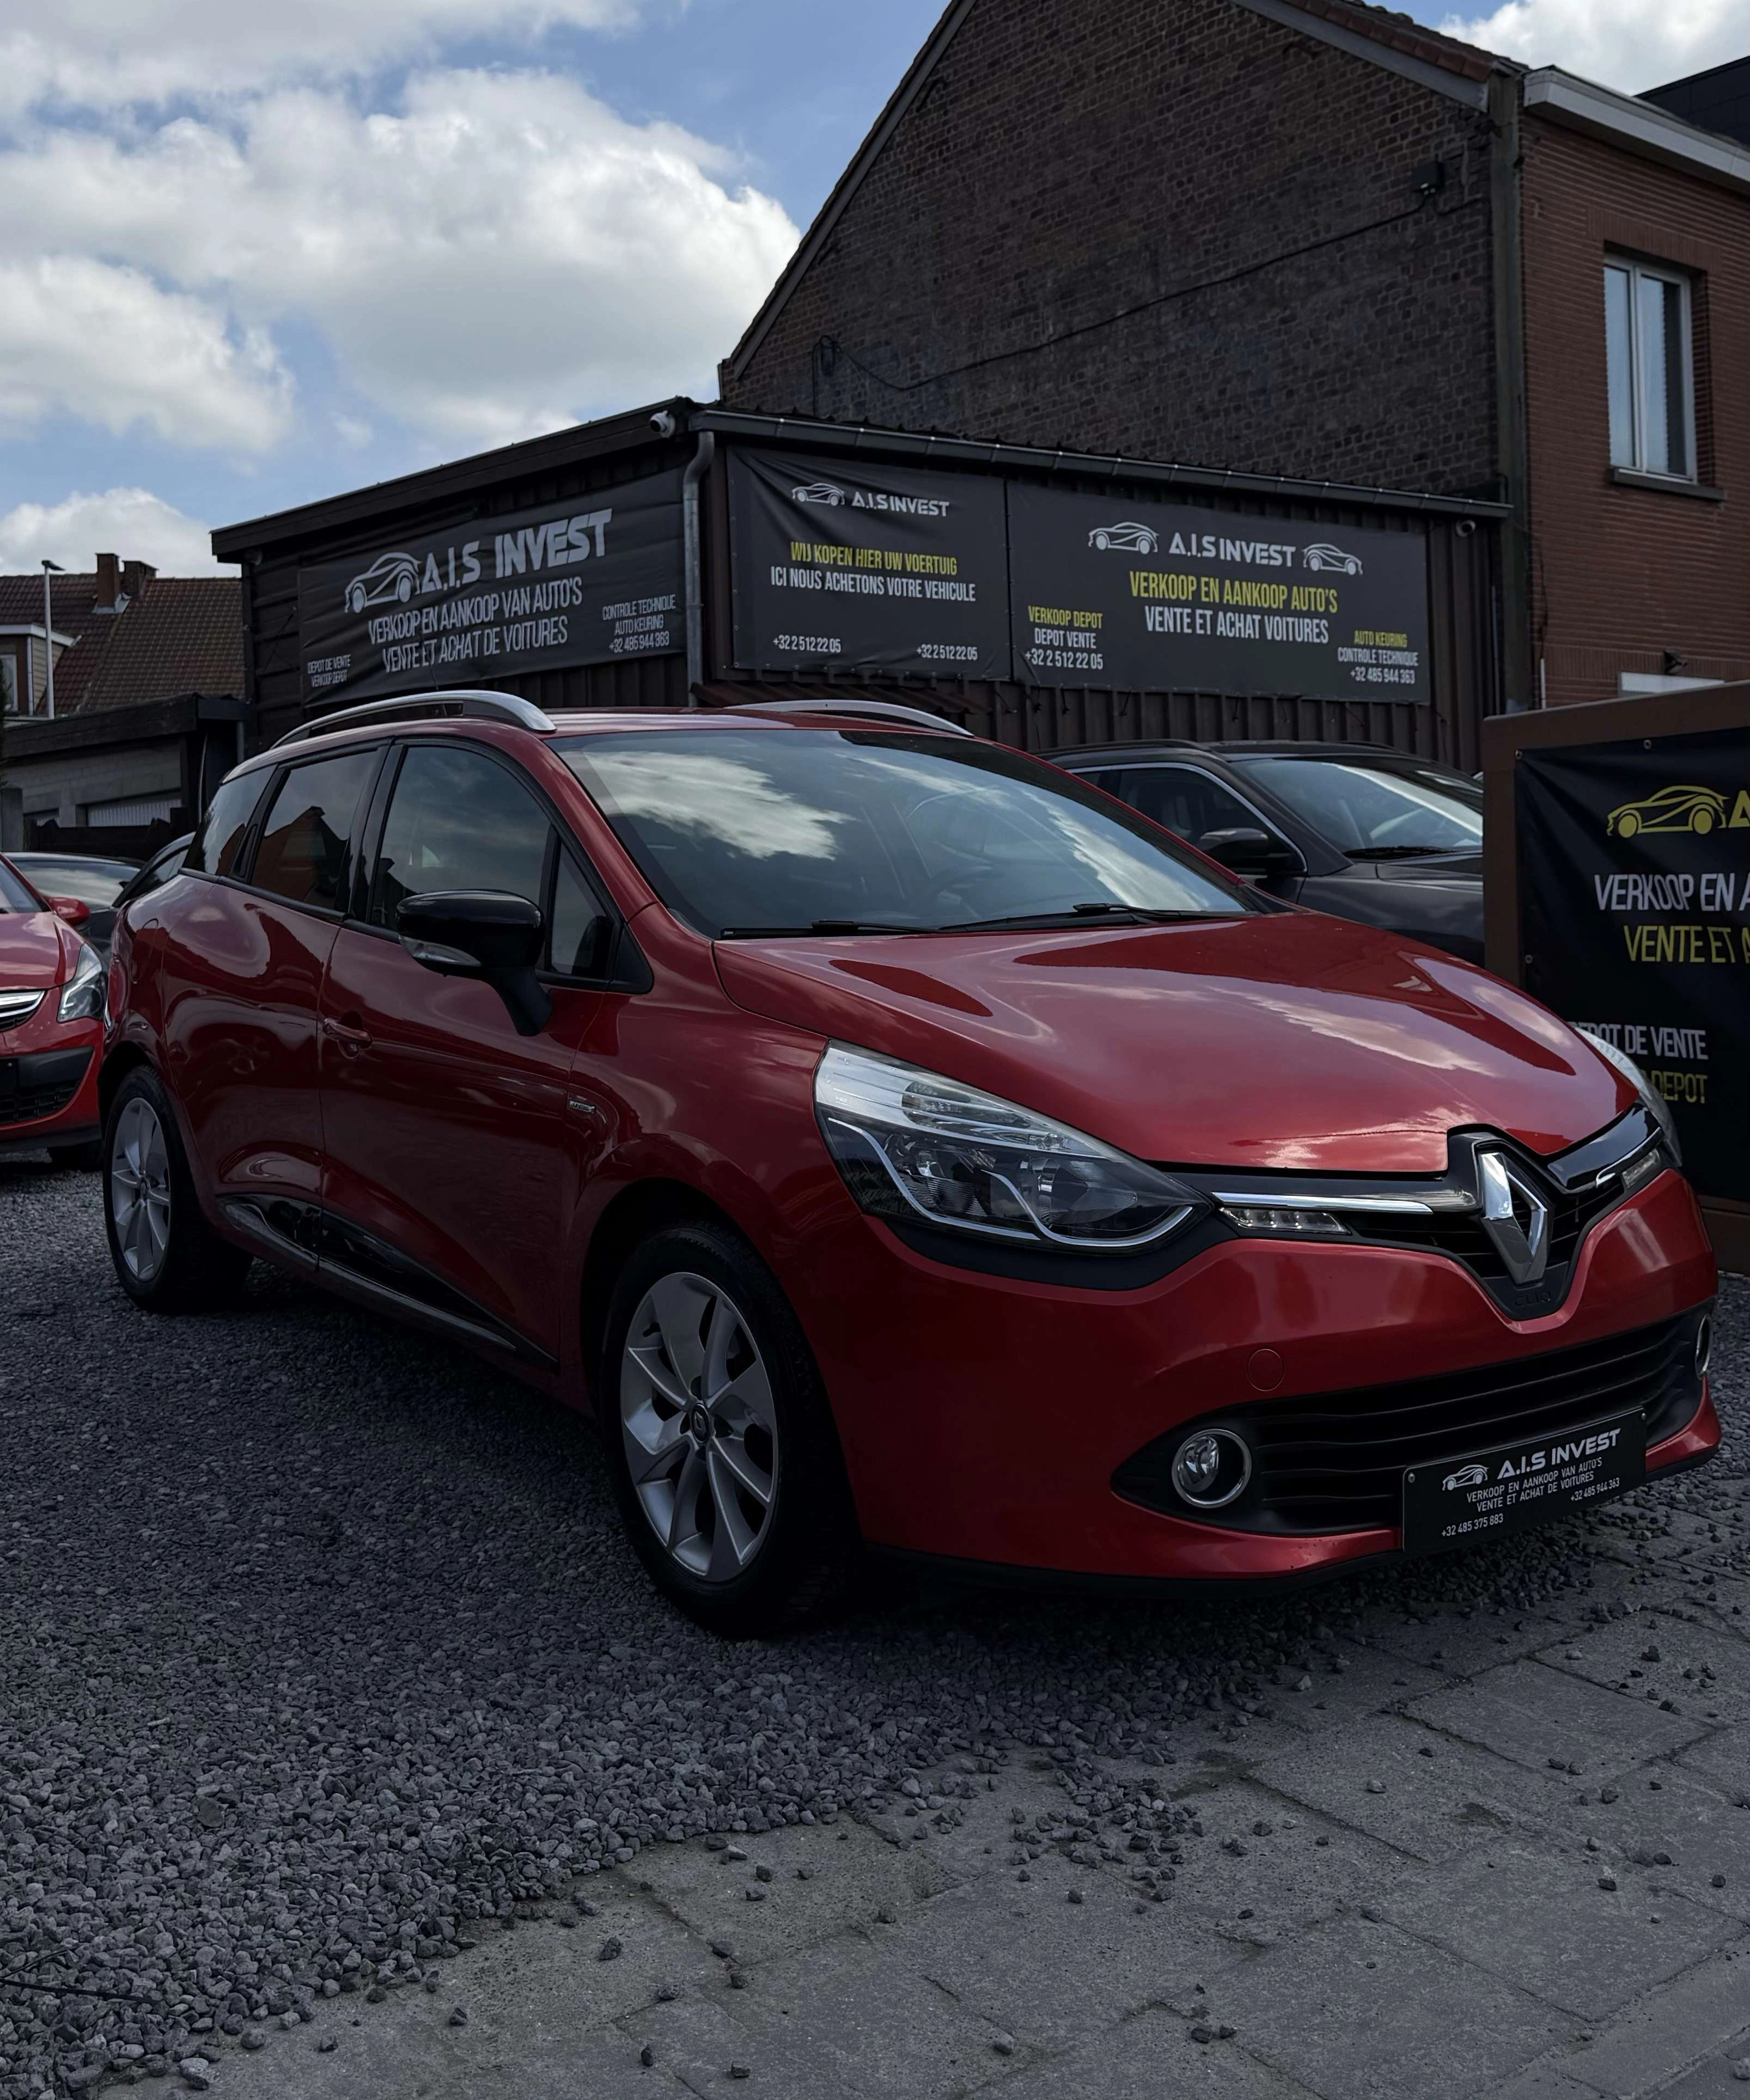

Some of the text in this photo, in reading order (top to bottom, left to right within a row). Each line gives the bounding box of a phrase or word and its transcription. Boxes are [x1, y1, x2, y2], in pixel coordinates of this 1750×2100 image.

[889, 496, 950, 517] INVEST
[495, 508, 612, 578] INVEST
[790, 541, 957, 576] WIJ KOPEN HIER UW VOERTUIG
[1169, 532, 1296, 567] A.I.S INVEST
[771, 566, 976, 602] ICI NOUS ACHETONS VOTRE VEHICULE
[1130, 571, 1338, 613] VERKOOP EN AANKOOP AUTO'S
[368, 577, 582, 644] VERKOOP EN AANKOOP VAN AUTO'S
[603, 601, 637, 620] CONTROLE
[614, 614, 664, 636] AUTO KEURING
[1028, 606, 1103, 629] VERKOOP DEPOT
[1145, 606, 1329, 644] VENTE ET ACHAT VOITURES
[383, 615, 568, 673] VENTE ET ACHAT DE VOITURES
[609, 638, 624, 653] +32
[639, 633, 654, 649] 944
[1035, 627, 1096, 649] DEPOT VENTE
[1355, 630, 1374, 645] AUTO
[1025, 648, 1044, 665] +32
[1055, 651, 1074, 668] 512
[1076, 652, 1089, 668] 22
[1090, 653, 1103, 669] 05
[1594, 874, 1694, 910] VERKOOP
[1700, 873, 1735, 911] EN
[1623, 925, 1705, 962] VENTE
[1706, 926, 1735, 963] ET
[1624, 1024, 1648, 1055] DE
[1650, 1026, 1709, 1060] VENTE
[1497, 1428, 1620, 1480] A.I.S INVEST
[1467, 1457, 1602, 1503] VERKOOP EN AANKOOP VAN AUTO'S
[1477, 1472, 1594, 1512] VENTE ET ACHAT DE VOITURES
[1571, 1490, 1583, 1501] +32
[1442, 1513, 1503, 1536] +32 485 375 883
